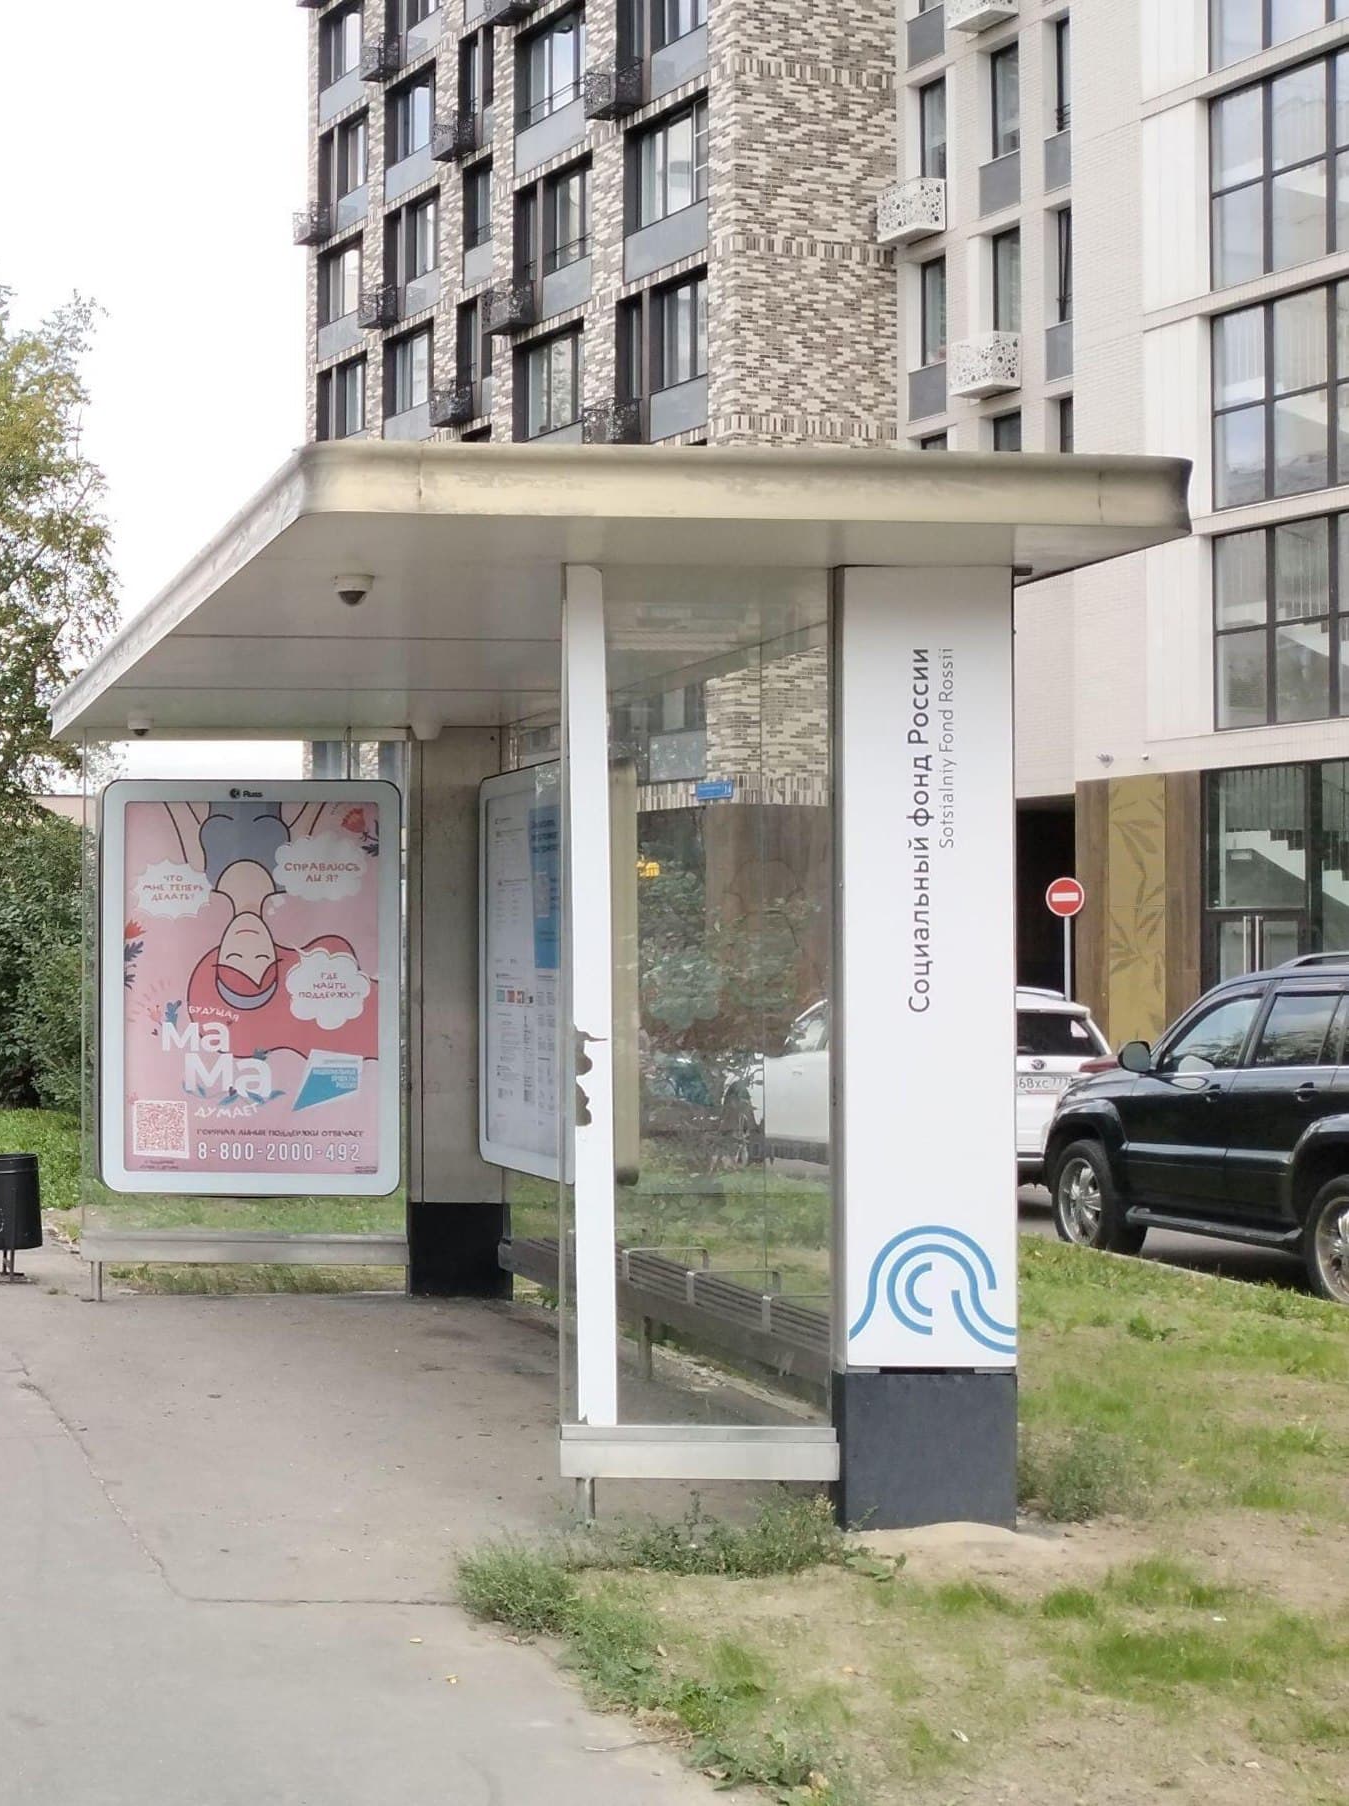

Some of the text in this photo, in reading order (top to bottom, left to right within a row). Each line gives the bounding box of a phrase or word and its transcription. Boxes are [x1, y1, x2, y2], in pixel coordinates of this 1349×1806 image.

[937, 648, 958, 849] Sotsialniy Fond Rossii
[906, 648, 935, 1013] Социальный фонд России
[284, 861, 361, 873] СПРАВЛЮСЬ
[163, 874, 184, 882] ЧТО
[169, 884, 204, 892] ТЕПЕРЬ
[321, 972, 338, 980] ГДЕ
[194, 1102, 259, 1119] ДУМАЕТ
[197, 1141, 362, 1161] 8-800-2000-492
